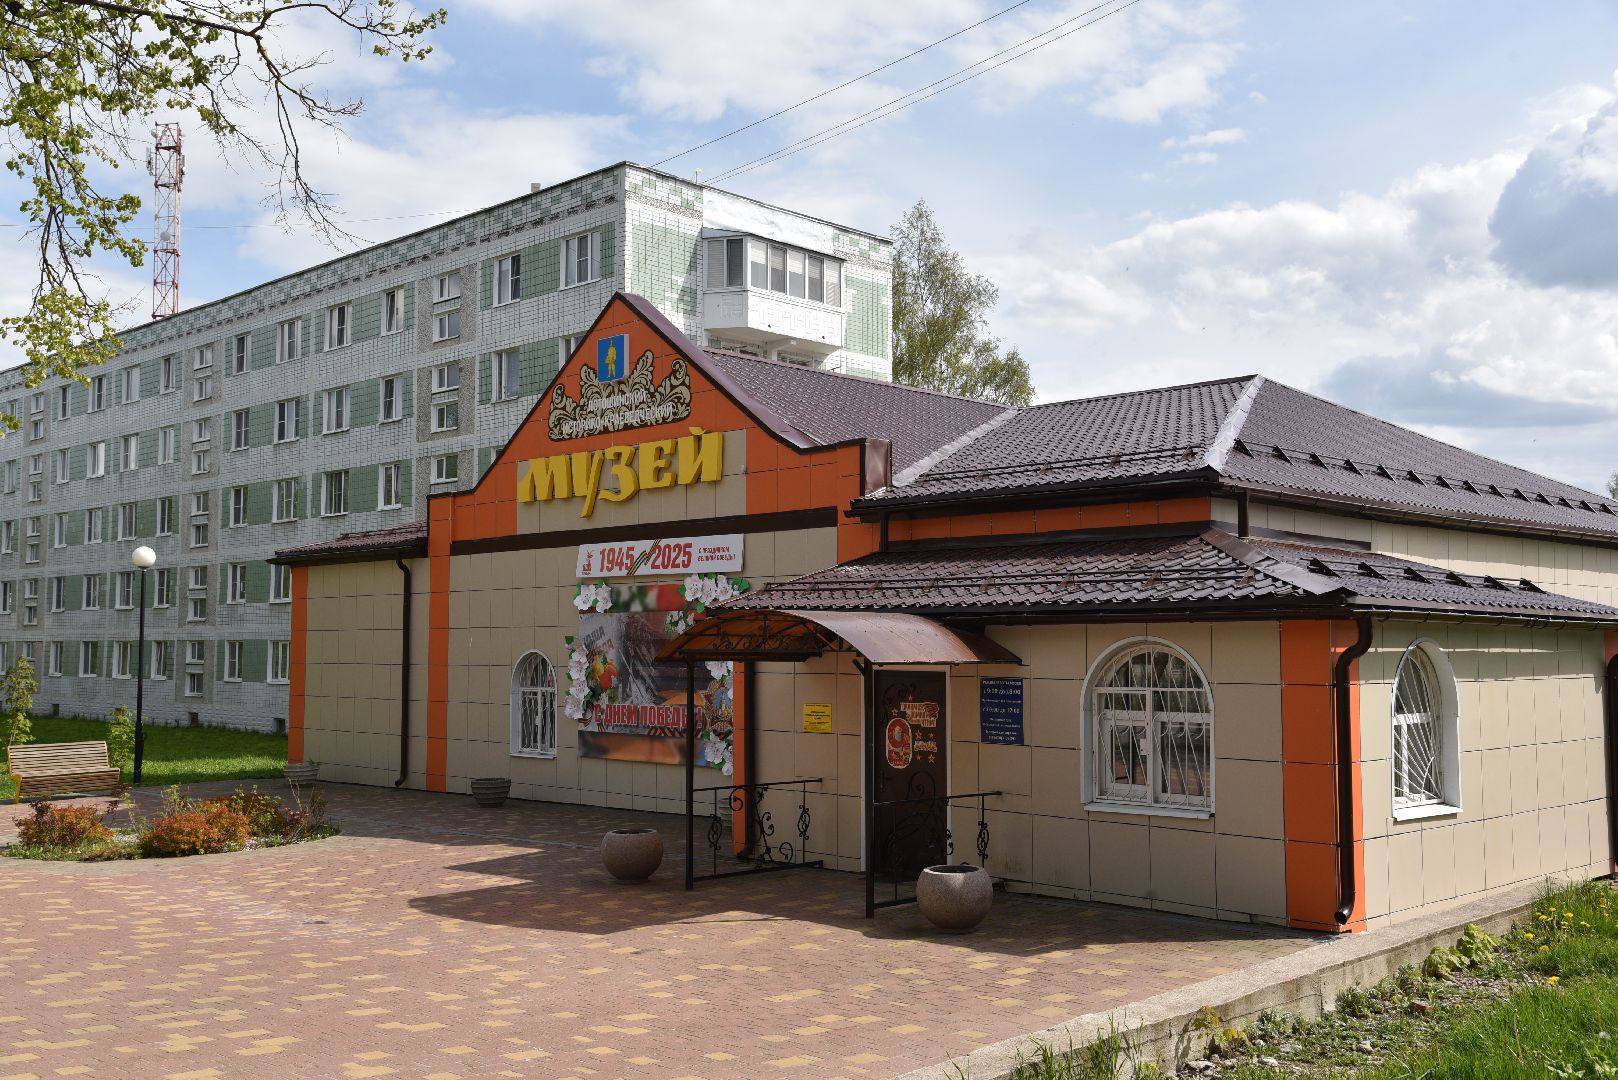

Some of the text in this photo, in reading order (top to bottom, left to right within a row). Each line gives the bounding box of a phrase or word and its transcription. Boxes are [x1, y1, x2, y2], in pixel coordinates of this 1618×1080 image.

[517, 426, 724, 518] МУЗЕЙ
[599, 543, 693, 573] 1945 2025
[594, 704, 602, 723] С
[604, 704, 638, 726] ДНЕМ
